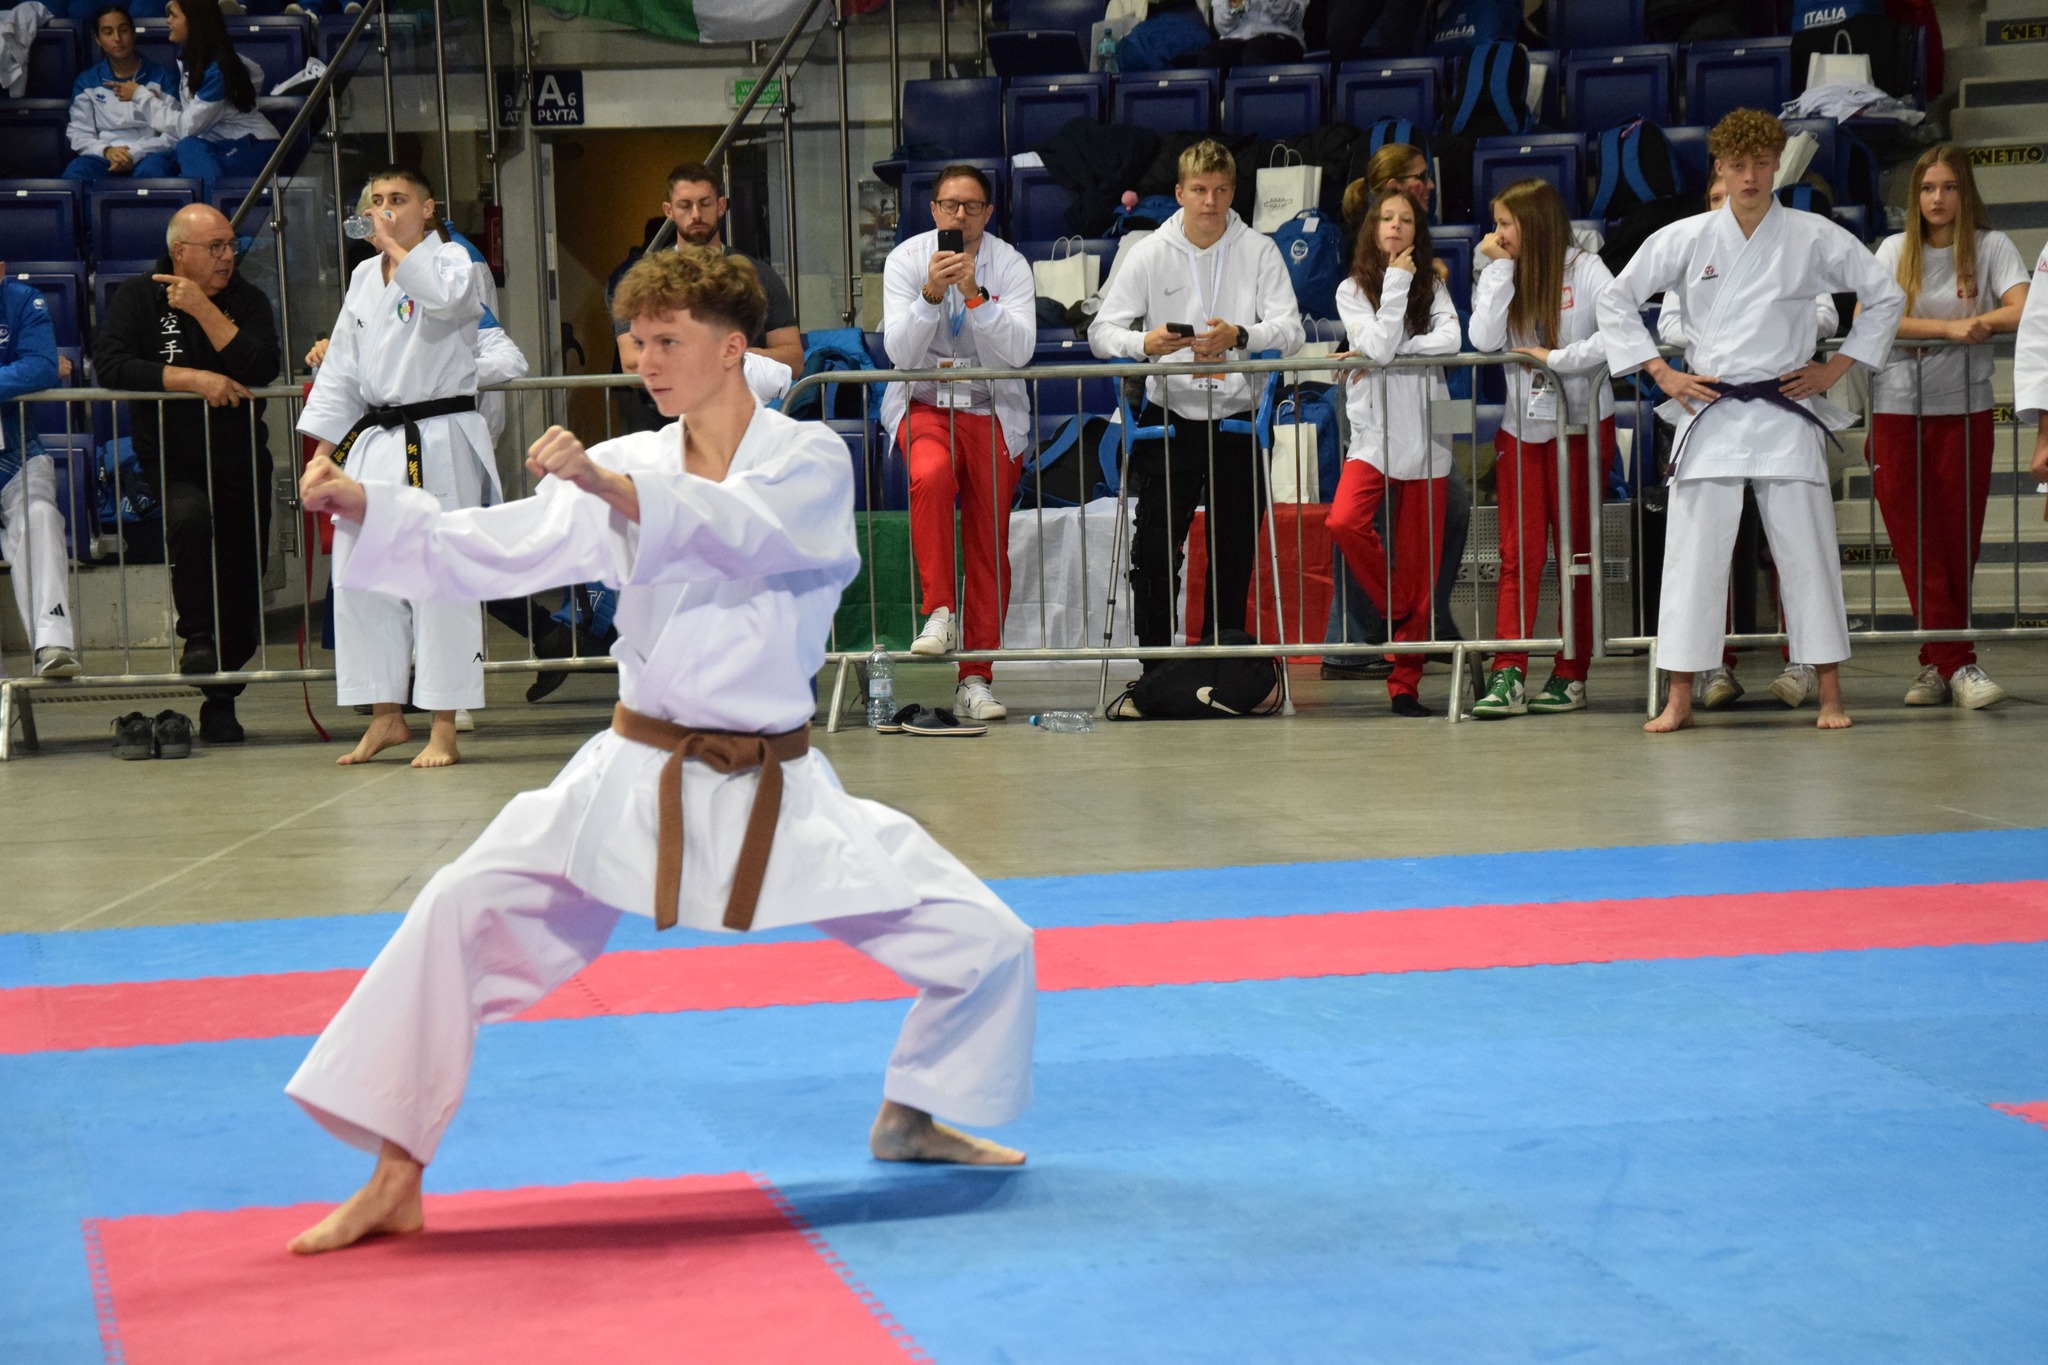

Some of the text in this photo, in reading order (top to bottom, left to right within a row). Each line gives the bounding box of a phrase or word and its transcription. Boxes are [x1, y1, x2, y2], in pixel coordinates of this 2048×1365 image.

[1803, 6, 1847, 26] ITALIA
[537, 74, 577, 107] A 6
[537, 108, 578, 121] PŁYTA
